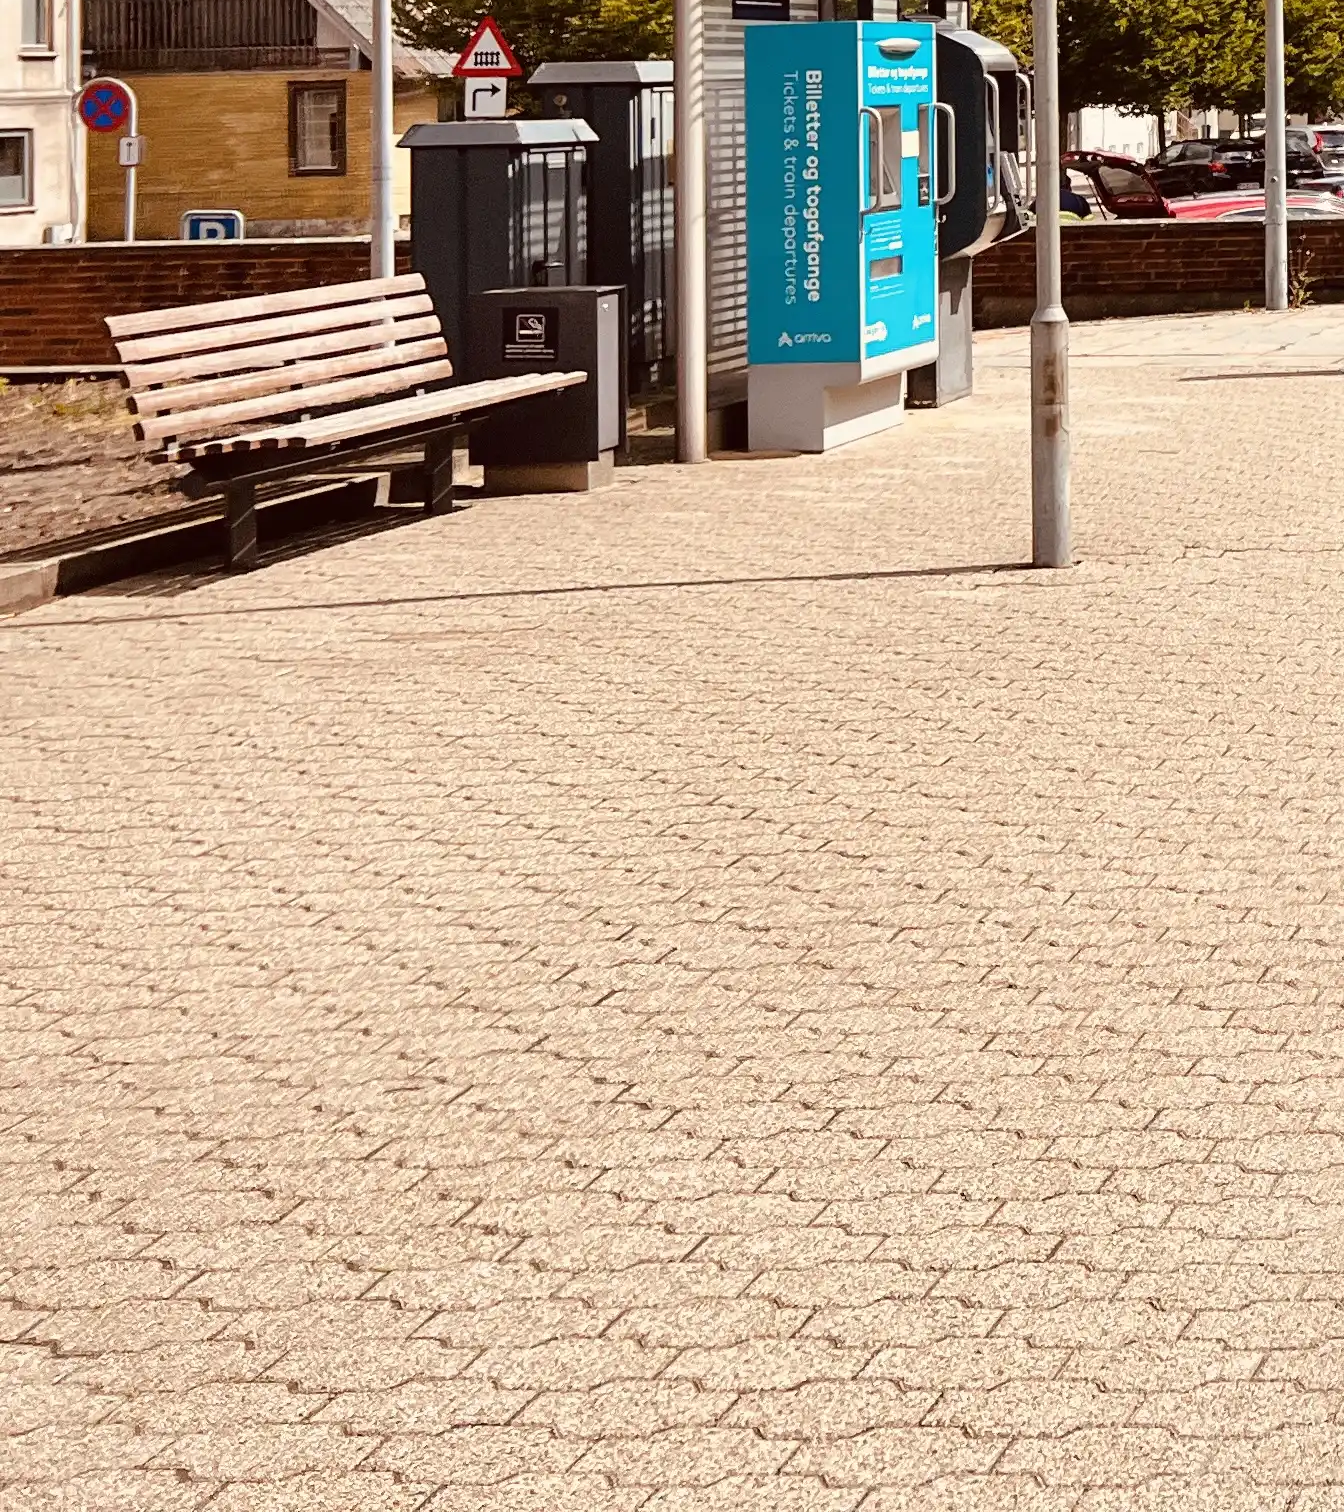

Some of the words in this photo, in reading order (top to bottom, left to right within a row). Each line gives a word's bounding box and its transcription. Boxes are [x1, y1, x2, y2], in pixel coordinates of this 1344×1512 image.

[783, 70, 799, 134] Tickets
[805, 69, 823, 151] Billetter
[783, 138, 799, 151] &
[802, 155, 819, 180] og
[783, 155, 799, 199] train
[781, 204, 800, 305] departures
[802, 184, 825, 302] togafgange
